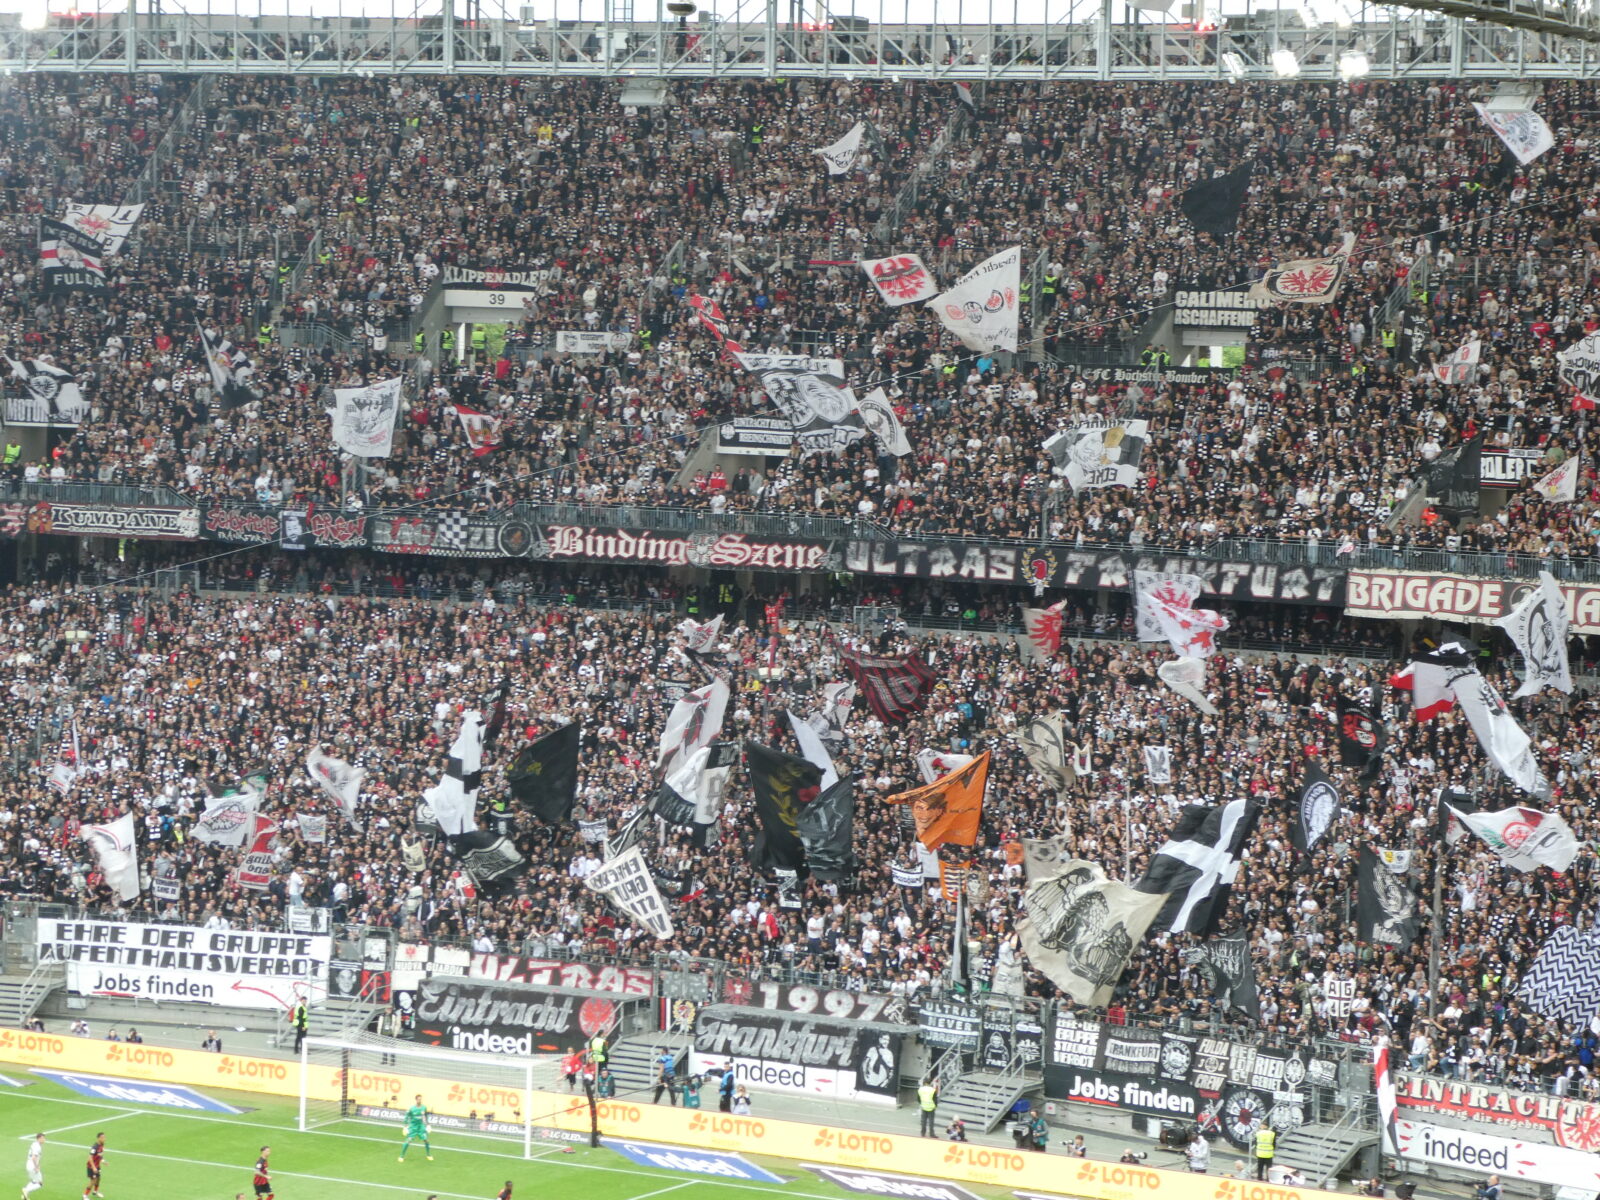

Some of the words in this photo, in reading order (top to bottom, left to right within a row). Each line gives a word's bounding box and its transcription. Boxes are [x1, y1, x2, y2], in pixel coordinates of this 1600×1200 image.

[53, 272, 104, 288] FULDA
[489, 294, 505, 305] 39
[51, 506, 179, 530] KUMPANE
[311, 512, 367, 541] CREW
[547, 526, 689, 565] Binding
[710, 533, 825, 569] Szene
[847, 541, 1014, 580] ULTRAS
[1348, 576, 1503, 614] BRIGADE
[56, 923, 127, 945] EHRE
[142, 928, 195, 949] DER
[209, 933, 313, 956] GRUPPE
[40, 943, 324, 977] AUFENTHALTSVERBOT
[94, 972, 141, 993] Jobs
[147, 974, 213, 998] finden
[469, 953, 653, 996] ULTRAS
[417, 981, 574, 1033] Eintracht
[759, 983, 891, 1021] 1997
[925, 1002, 977, 1018] ULTRAS
[928, 1017, 972, 1031] NEVER
[19, 1032, 63, 1053] LOTTO
[452, 1027, 532, 1054] indeed
[695, 1013, 859, 1066] Frankfurt
[1109, 1042, 1159, 1059] FRANKFURT
[1200, 1038, 1230, 1056] FULDA
[126, 1047, 173, 1067] LOTTO
[1254, 1056, 1285, 1079] RIED
[239, 1060, 286, 1080] LOTTO
[353, 1070, 401, 1093] LOTTO
[1069, 1075, 1119, 1103] Jobs
[1122, 1083, 1195, 1113] finden
[1194, 1074, 1226, 1091] CREW
[469, 1086, 519, 1108] LOTTO
[1394, 1074, 1583, 1125] EINTRACHT
[712, 1118, 765, 1139] LOTTO
[1414, 1104, 1436, 1114] auf
[1439, 1107, 1468, 1121] ewig
[1473, 1111, 1492, 1123] dir
[1496, 1115, 1547, 1131] ergeben
[839, 1134, 893, 1154] LOTTO
[1425, 1133, 1508, 1170] indeed
[968, 1151, 1024, 1171] LOTTO
[1102, 1166, 1160, 1189] LOTTO
